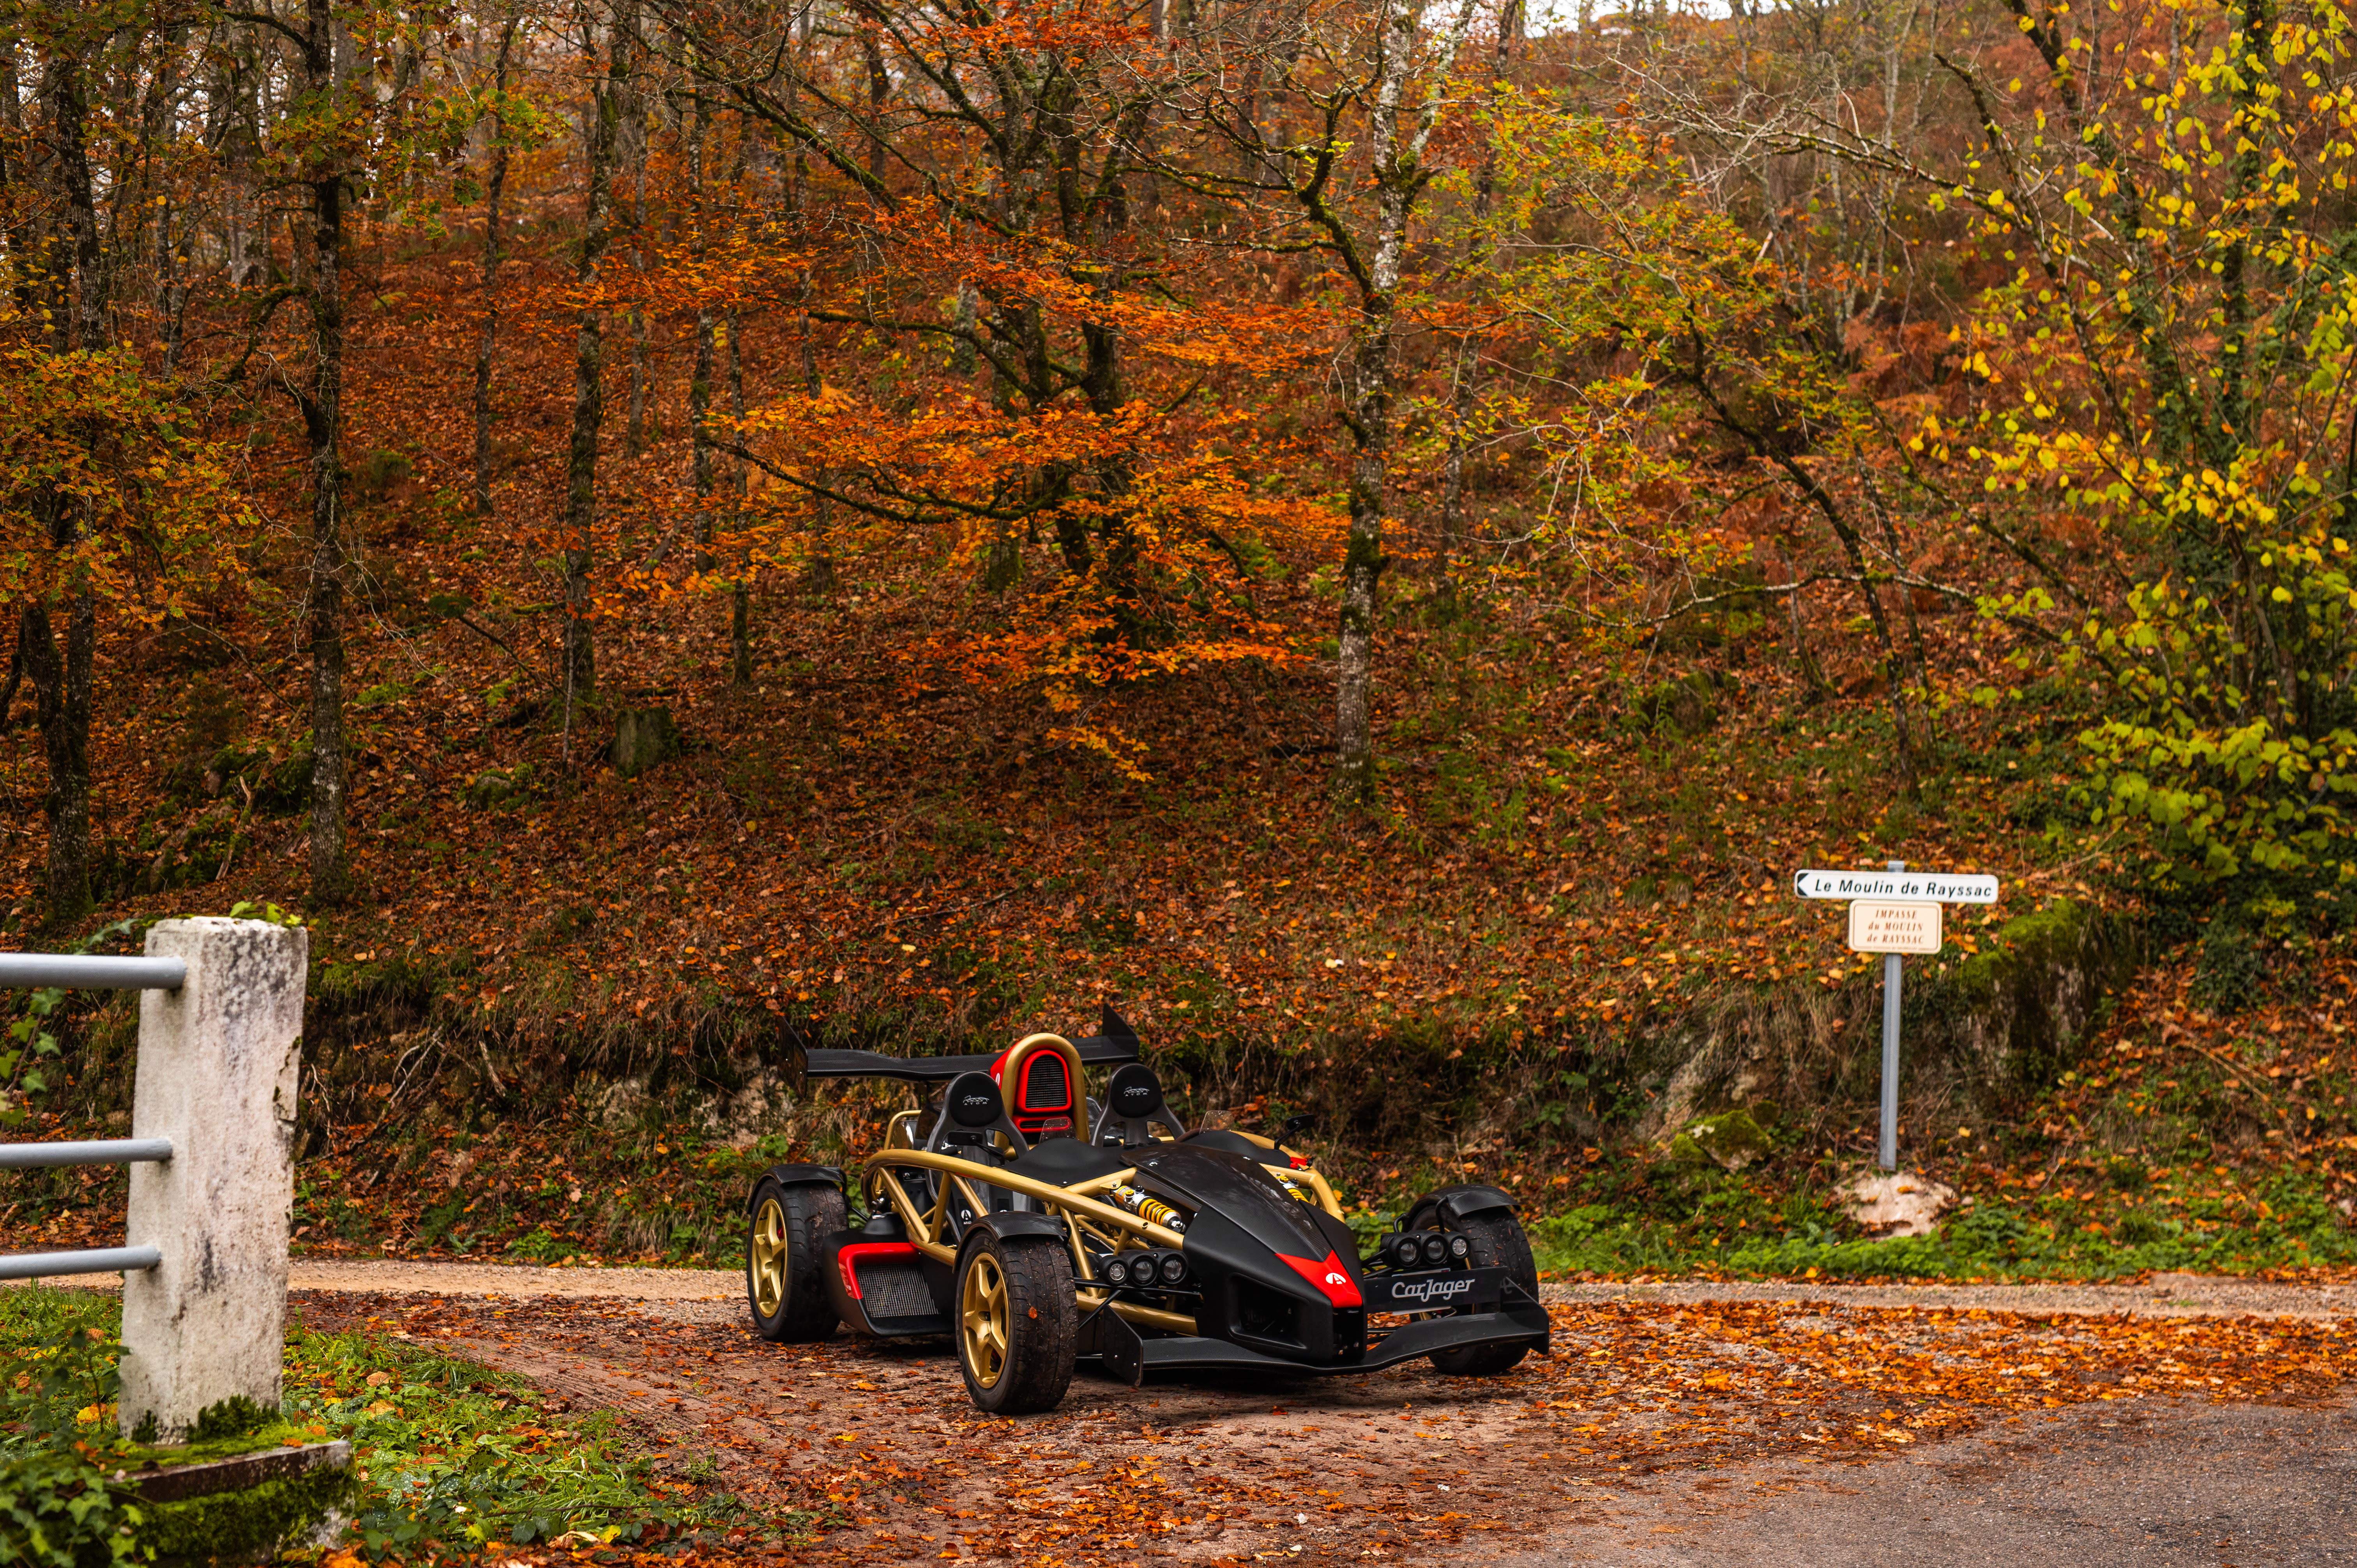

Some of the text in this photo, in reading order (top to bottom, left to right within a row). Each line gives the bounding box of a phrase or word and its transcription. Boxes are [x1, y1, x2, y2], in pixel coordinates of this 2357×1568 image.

[1815, 879, 1991, 899] Le Moulin de Rayssac
[1875, 909, 1917, 920] IMPASSE
[1868, 921, 1923, 932] du MOULIN
[1866, 933, 1924, 944] de RAYSSAC
